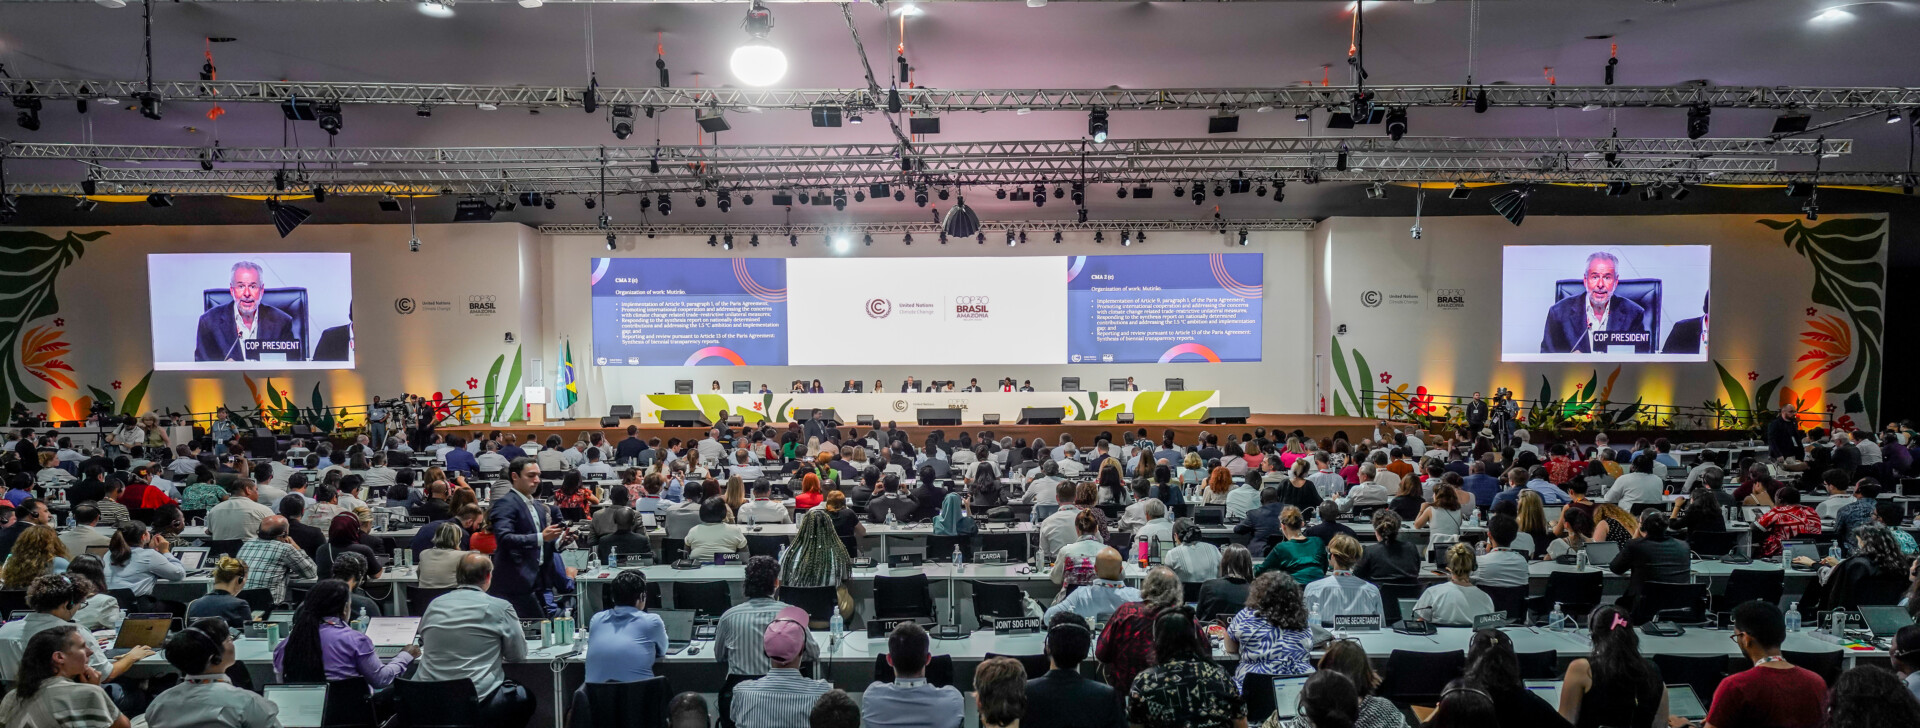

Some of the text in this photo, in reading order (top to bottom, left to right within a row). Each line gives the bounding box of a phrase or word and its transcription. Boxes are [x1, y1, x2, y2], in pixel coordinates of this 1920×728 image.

[956, 296, 989, 304] COP30
[246, 342, 259, 350] COP
[1480, 614, 1500, 623] UNAIDS
[996, 619, 1039, 629] JOINT SDG FUND
